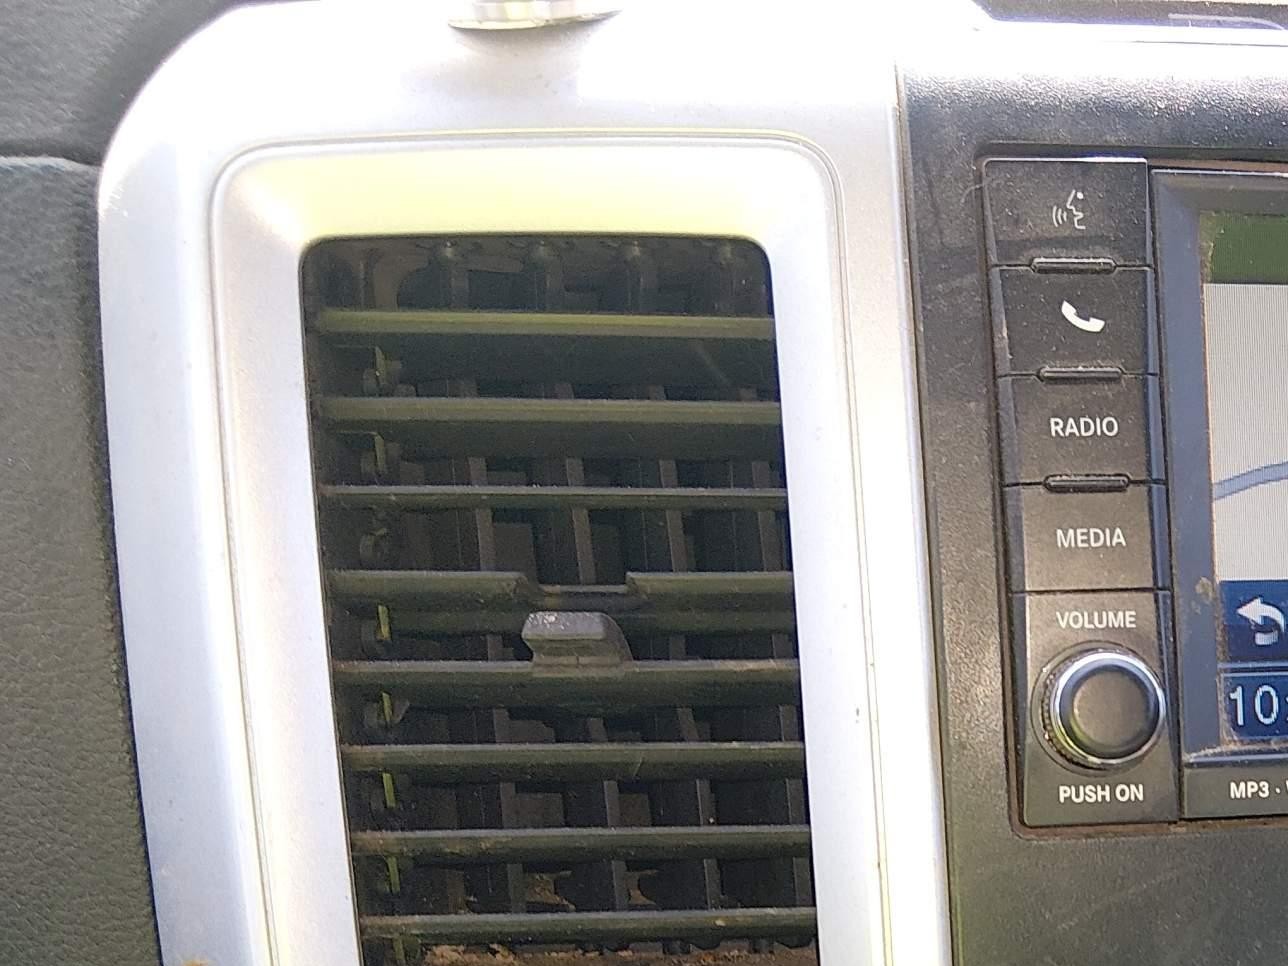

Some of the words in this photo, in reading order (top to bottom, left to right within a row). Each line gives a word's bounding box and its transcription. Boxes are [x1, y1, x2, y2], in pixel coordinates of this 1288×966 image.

[1049, 417, 1119, 438] RADIO
[1056, 528, 1126, 549] MEDIA
[1056, 611, 1136, 630] VOLUME
[1058, 785, 1110, 805] PUSH
[1115, 783, 1144, 803] ON
[1229, 779, 1270, 799] MP3
